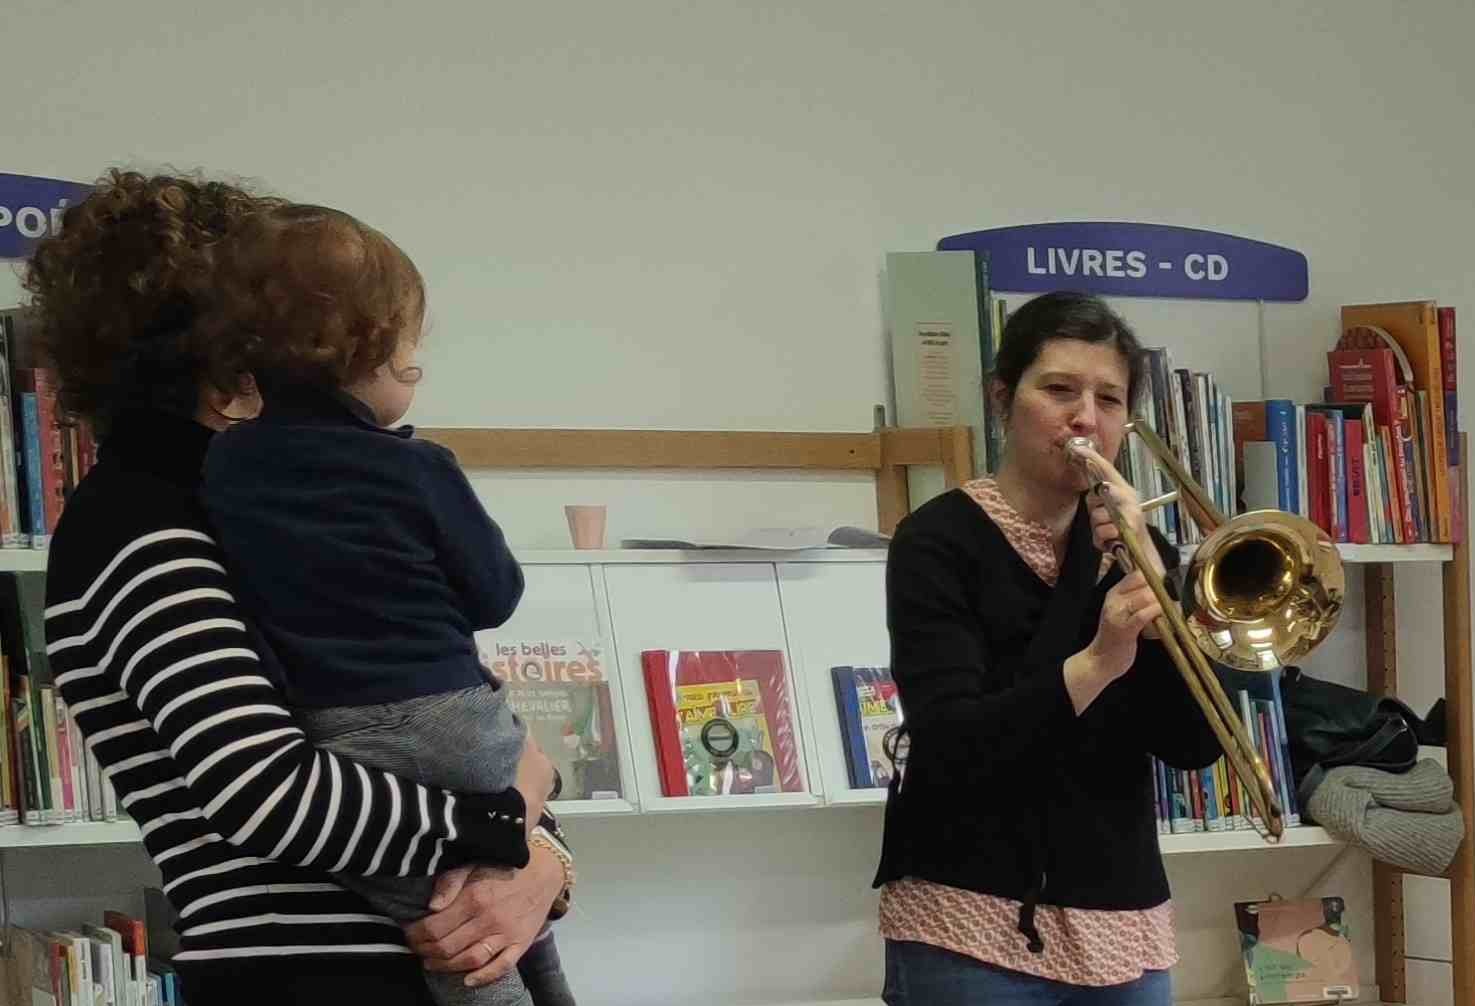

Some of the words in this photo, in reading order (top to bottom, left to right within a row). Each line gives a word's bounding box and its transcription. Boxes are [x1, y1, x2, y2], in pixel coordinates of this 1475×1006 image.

[1027, 247, 1147, 278] LIVRES
[1184, 253, 1230, 281] CD
[496, 642, 517, 656] les
[521, 642, 567, 659] belles
